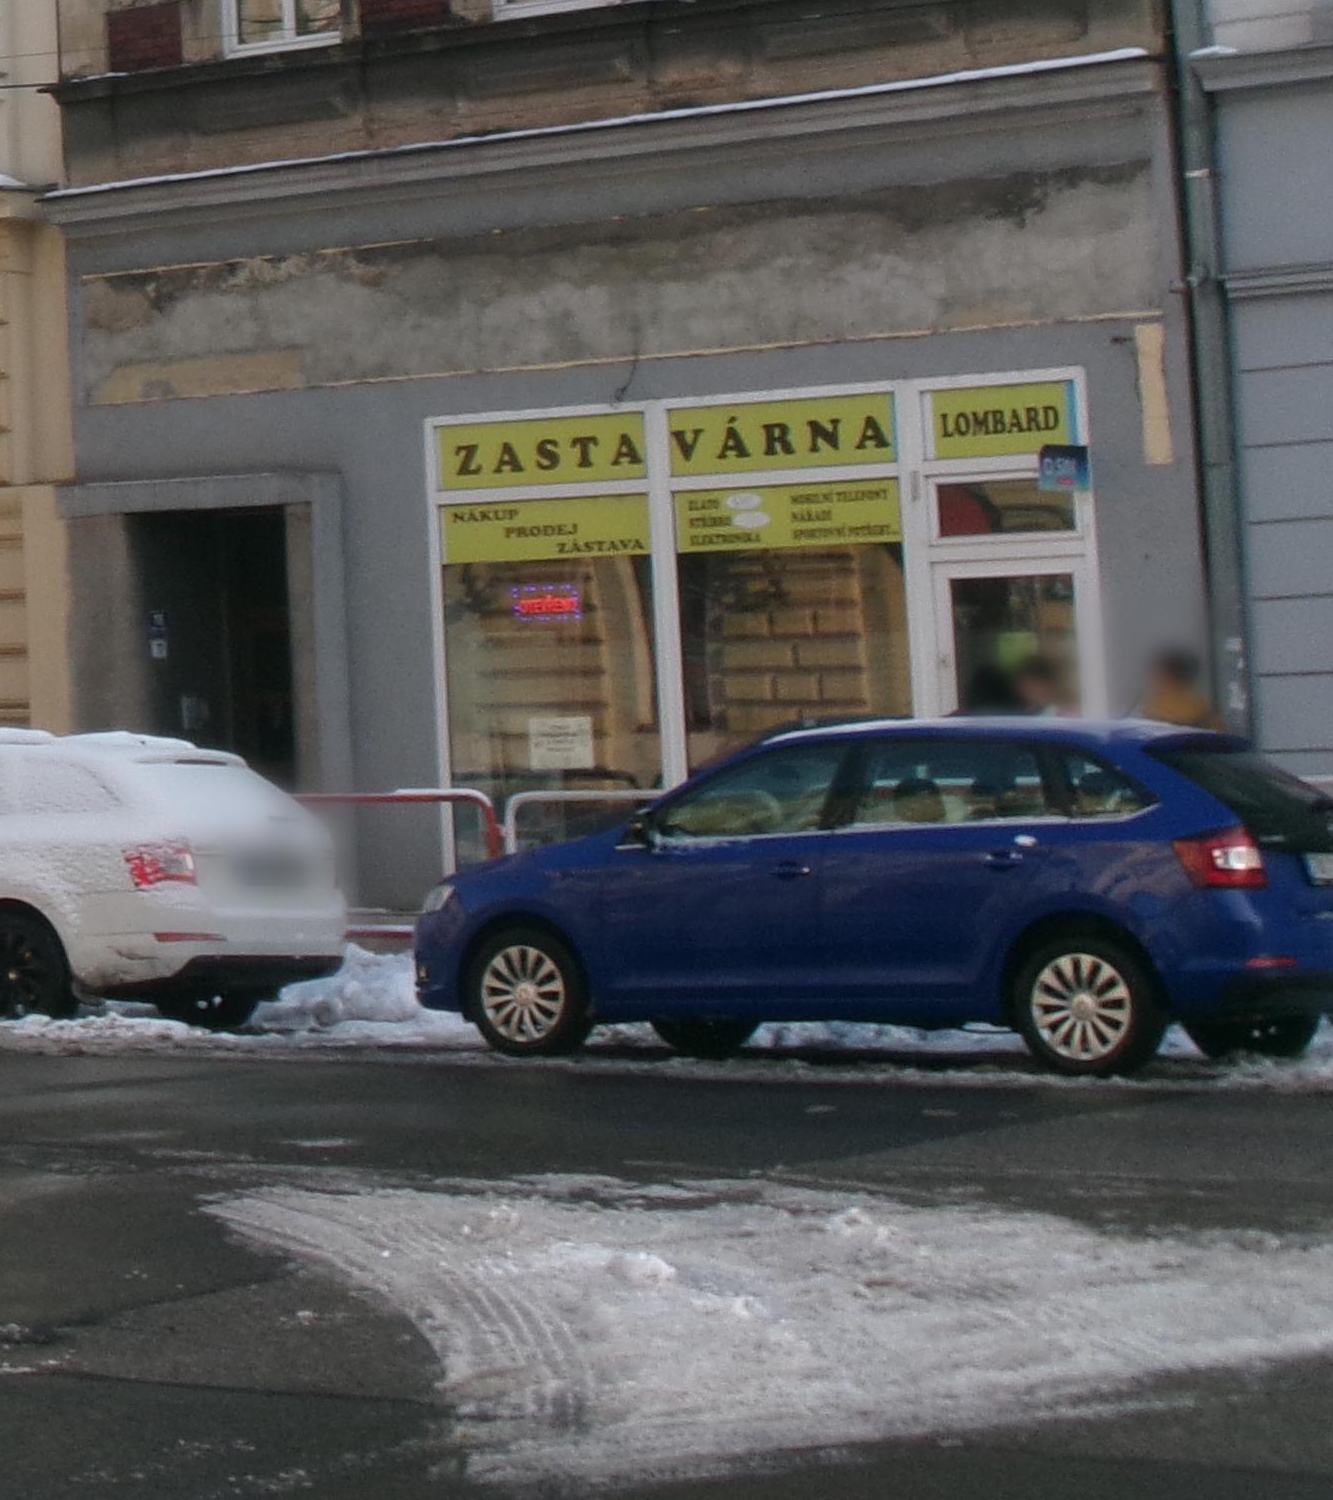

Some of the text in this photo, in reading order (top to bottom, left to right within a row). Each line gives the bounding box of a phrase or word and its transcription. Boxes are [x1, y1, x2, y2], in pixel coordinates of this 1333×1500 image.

[939, 404, 1061, 438] LOMBARD
[453, 415, 891, 476] ZASTAVÁRNA
[451, 508, 520, 524] NÁKUP
[503, 523, 579, 539] PRODEJ
[556, 538, 645, 554] ZÁSTAVA
